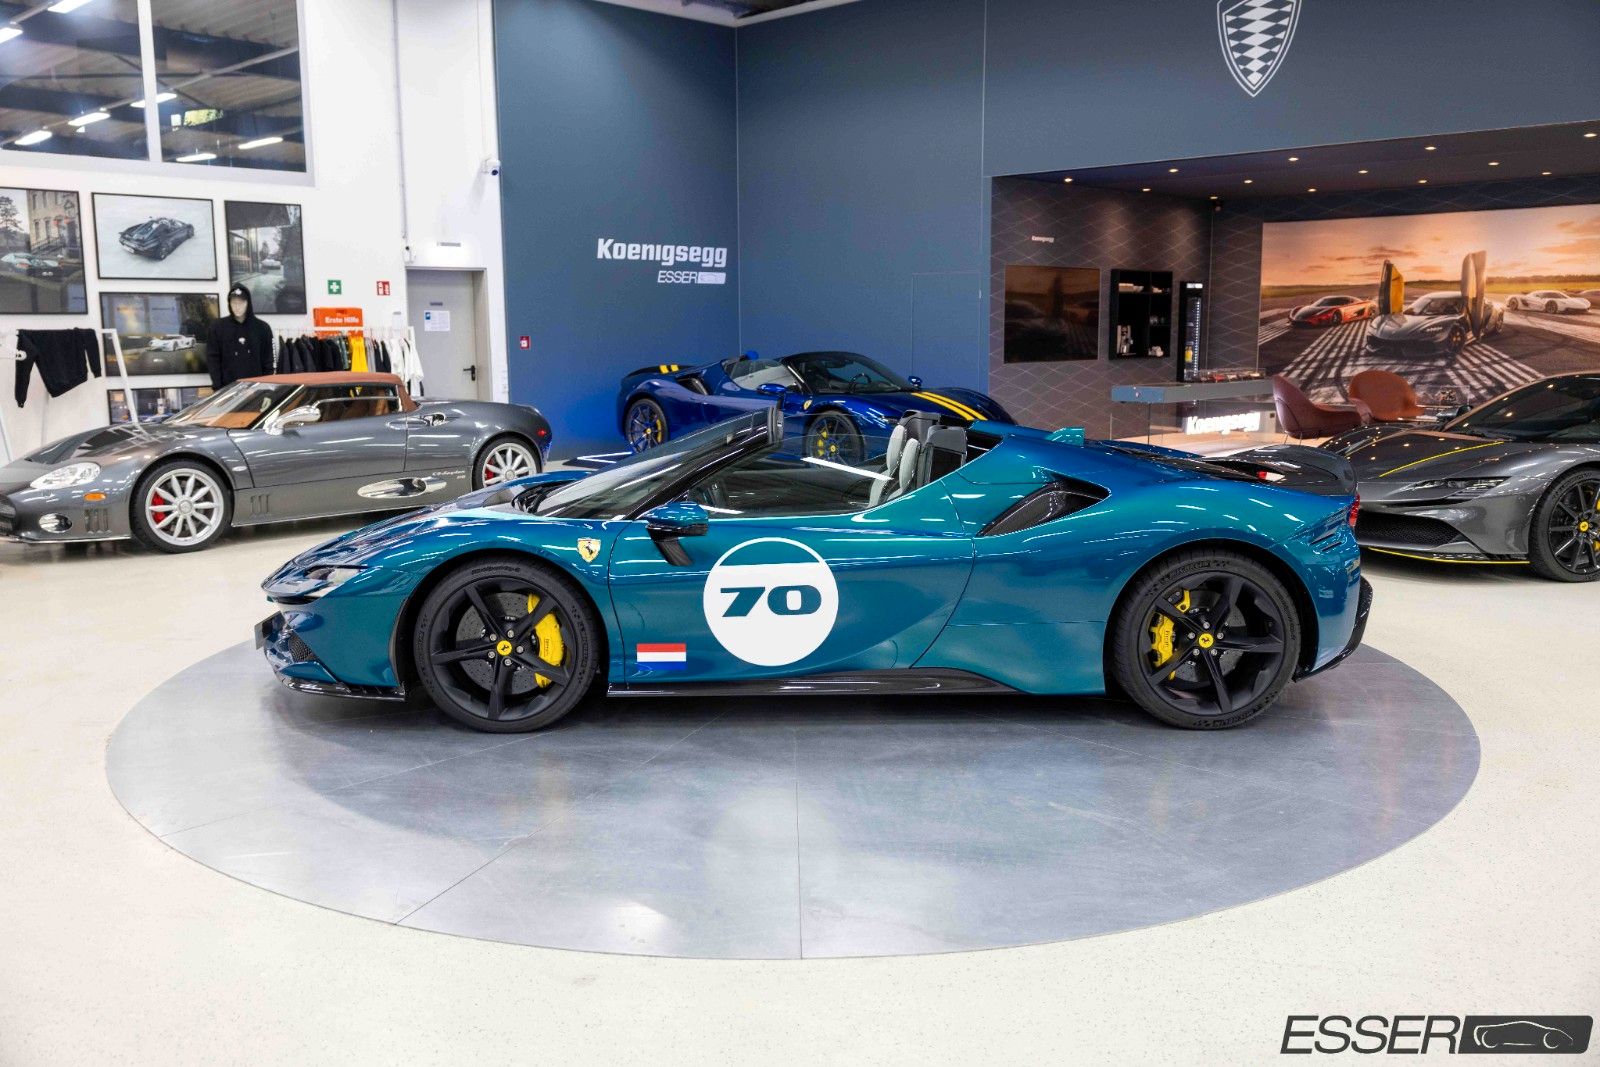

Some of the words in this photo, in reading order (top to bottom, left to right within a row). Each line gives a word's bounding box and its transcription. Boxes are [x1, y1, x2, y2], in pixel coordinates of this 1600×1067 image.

[597, 238, 728, 268] Koenigsegg
[657, 270, 698, 284] ESSER
[720, 584, 822, 618] 70
